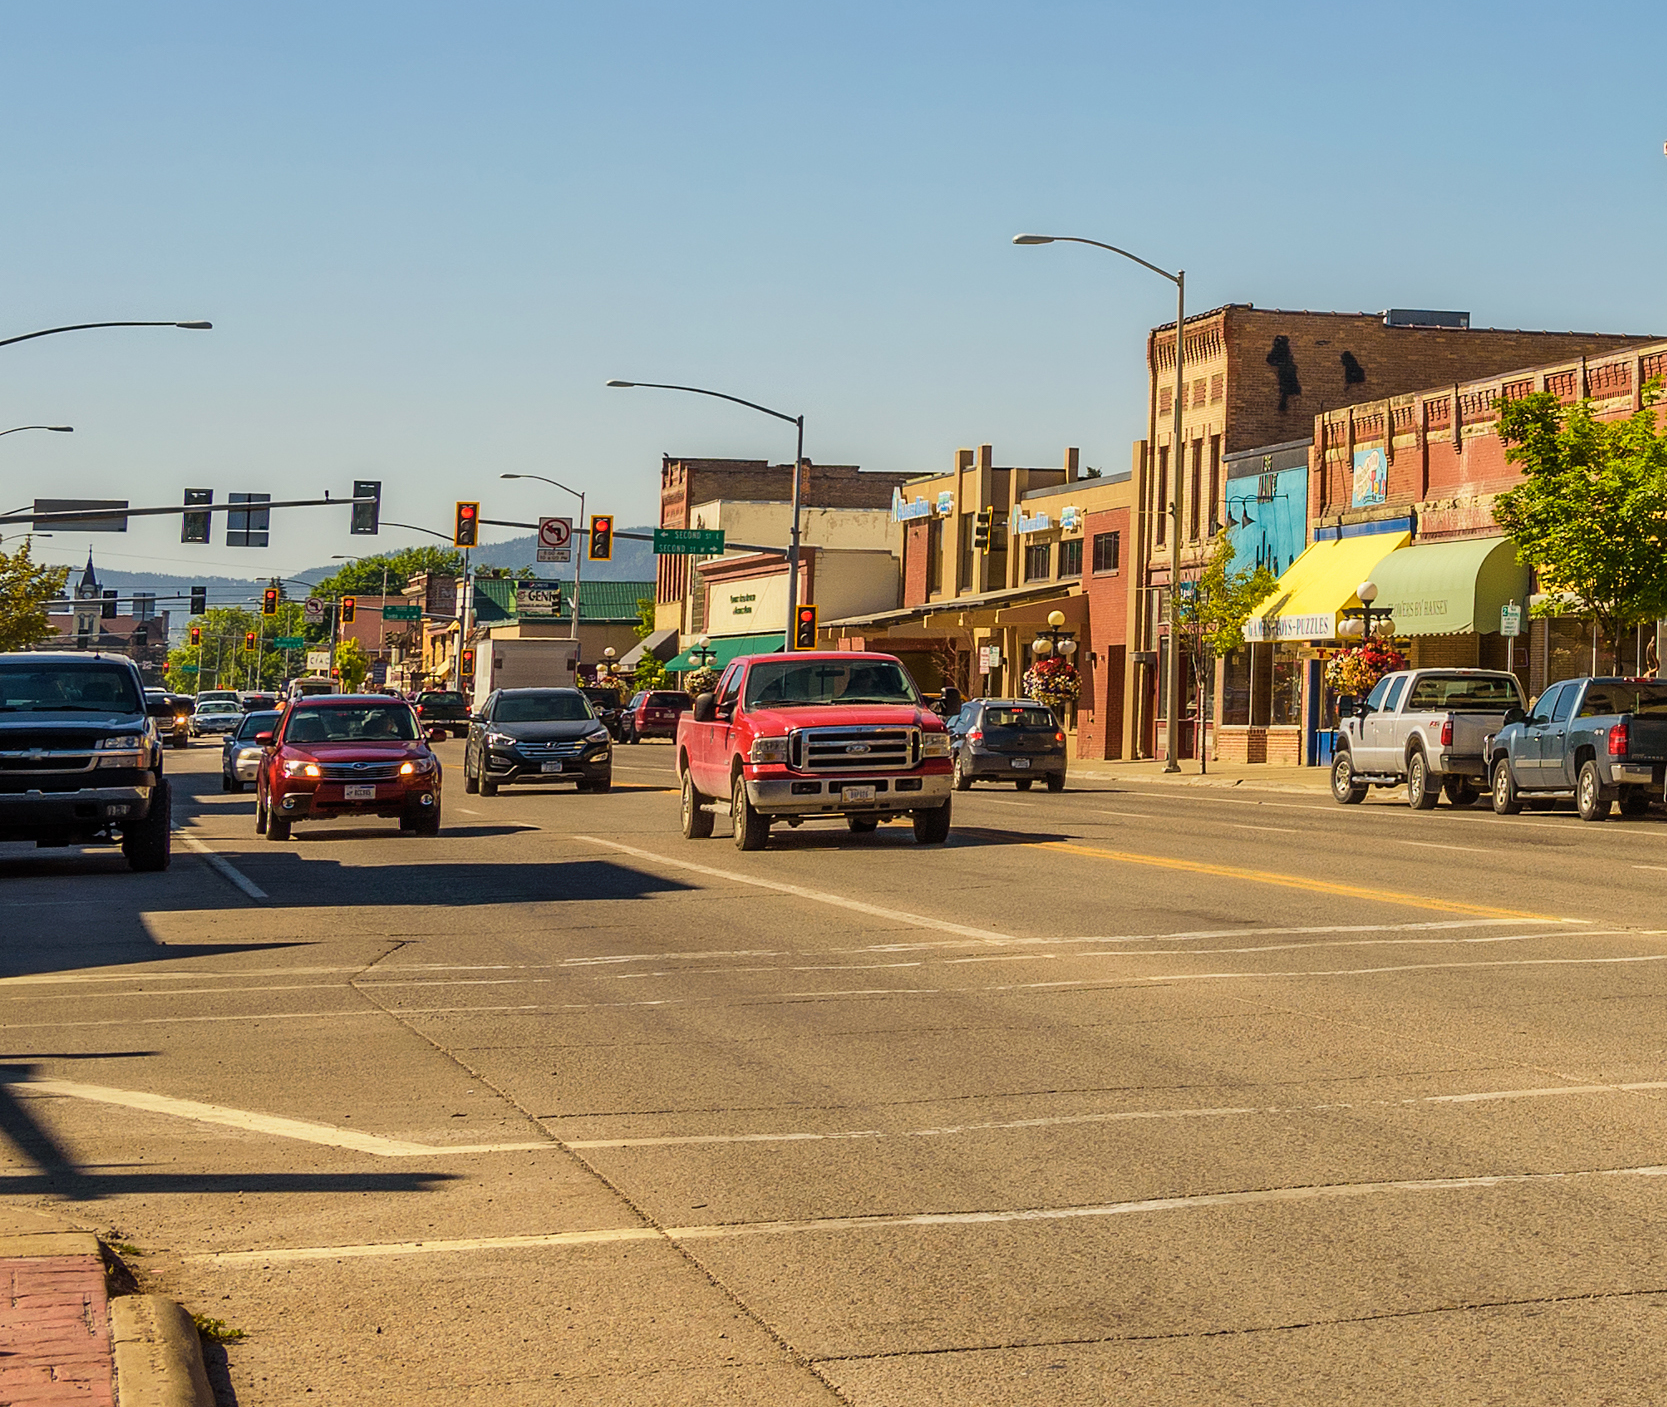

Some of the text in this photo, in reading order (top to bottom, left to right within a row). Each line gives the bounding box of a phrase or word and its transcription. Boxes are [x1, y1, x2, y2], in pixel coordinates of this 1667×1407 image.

[675, 530, 701, 540] SECOND
[658, 544, 686, 553] SECOND
[1424, 599, 1448, 616] HANSEN
